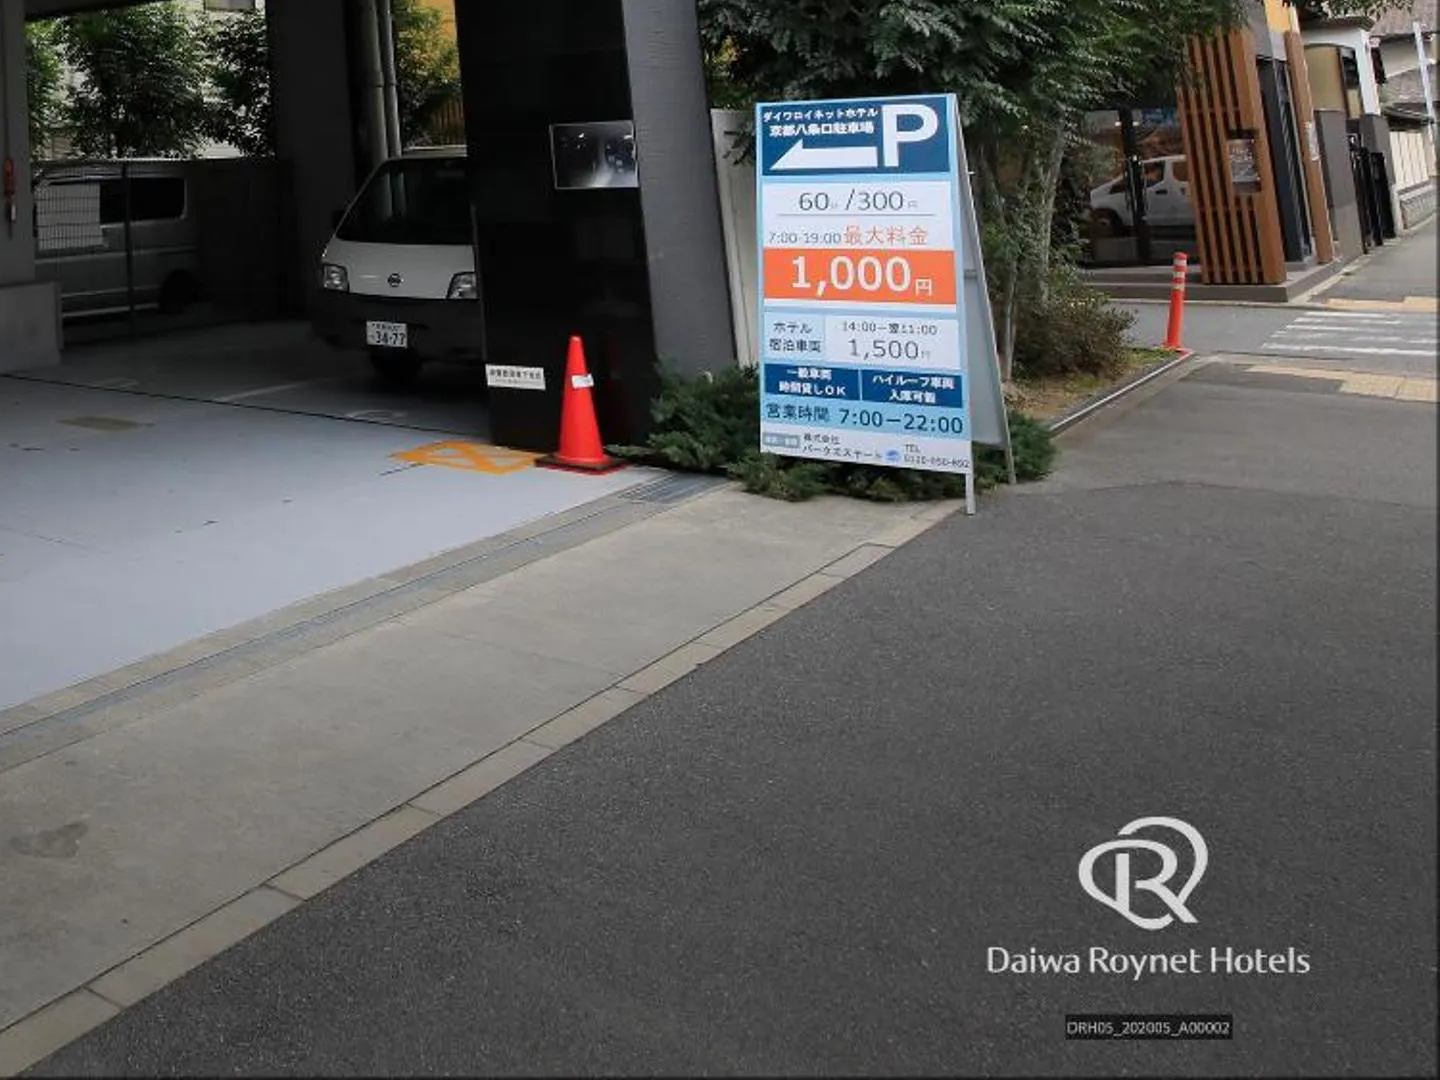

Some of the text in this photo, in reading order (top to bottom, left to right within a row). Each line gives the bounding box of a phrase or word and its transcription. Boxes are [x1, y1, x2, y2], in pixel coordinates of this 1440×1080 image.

[763, 107, 879, 123] ダイワロイネットホテル
[768, 121, 875, 137] 京都八条口駐車場
[880, 104, 938, 168] P
[844, 226, 928, 246] 最大料金
[773, 321, 813, 334] ホテル
[768, 338, 822, 354] 宿泊車両
[872, 376, 955, 391] ハイルーフ車両
[765, 402, 831, 421] 営業時間
